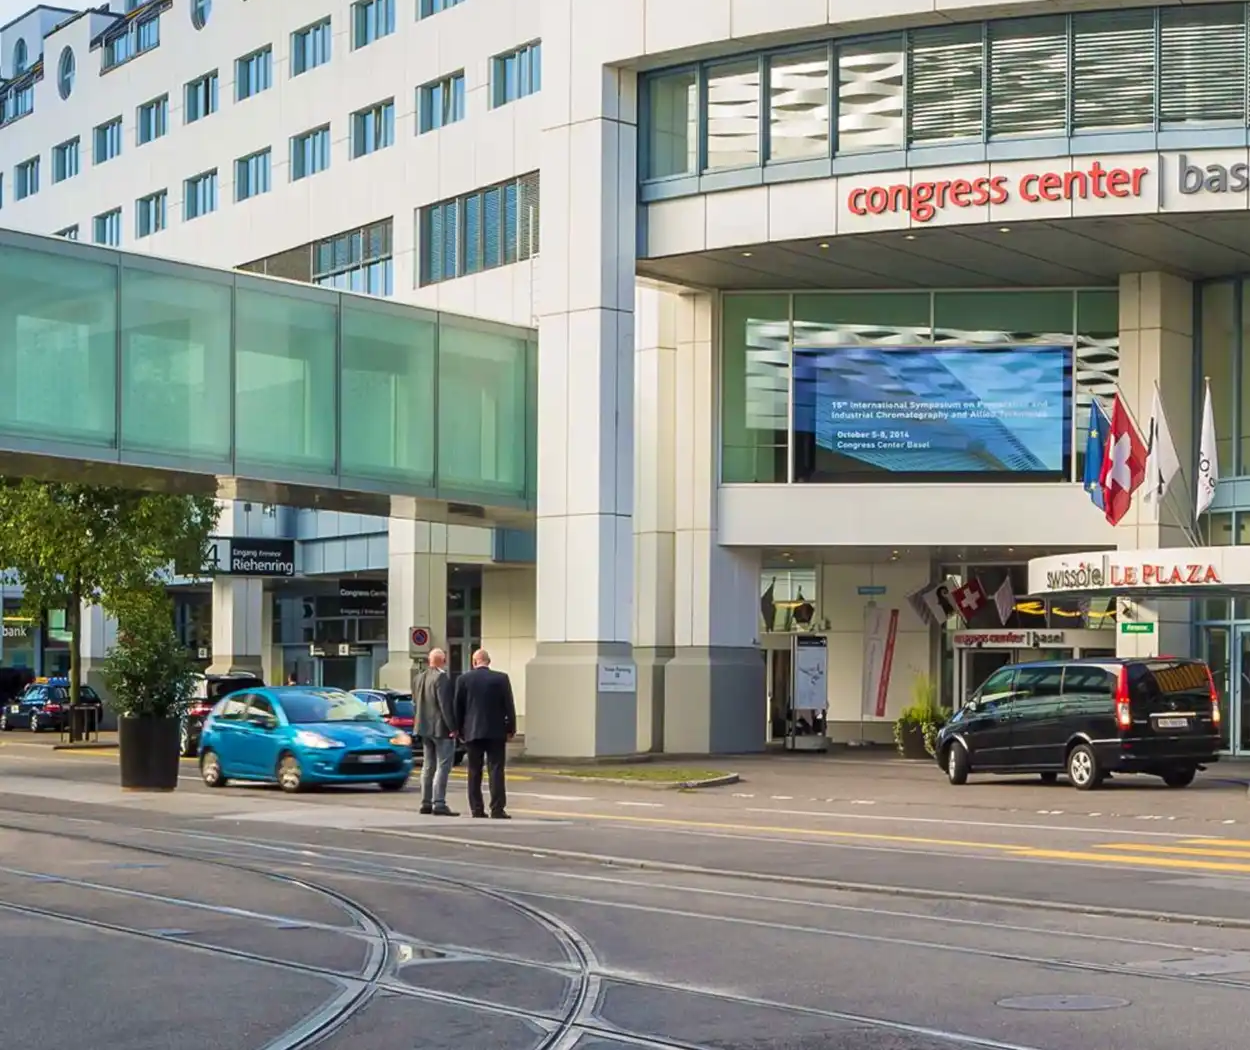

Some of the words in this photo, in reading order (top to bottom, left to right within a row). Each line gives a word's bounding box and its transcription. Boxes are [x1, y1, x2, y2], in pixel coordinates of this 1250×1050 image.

[848, 174, 1009, 222] congress
[1018, 161, 1149, 203] center
[850, 401, 907, 409] International
[909, 401, 961, 411] Symposium
[831, 411, 873, 419] Industrial
[875, 411, 948, 420] Chromatography
[837, 430, 870, 438] October
[889, 430, 910, 438] 2014
[837, 441, 875, 450] Congress
[233, 548, 257, 558] Eingang
[233, 557, 294, 575] Riehenring
[1110, 565, 1138, 586] LE
[1142, 564, 1222, 585] PLAZA
